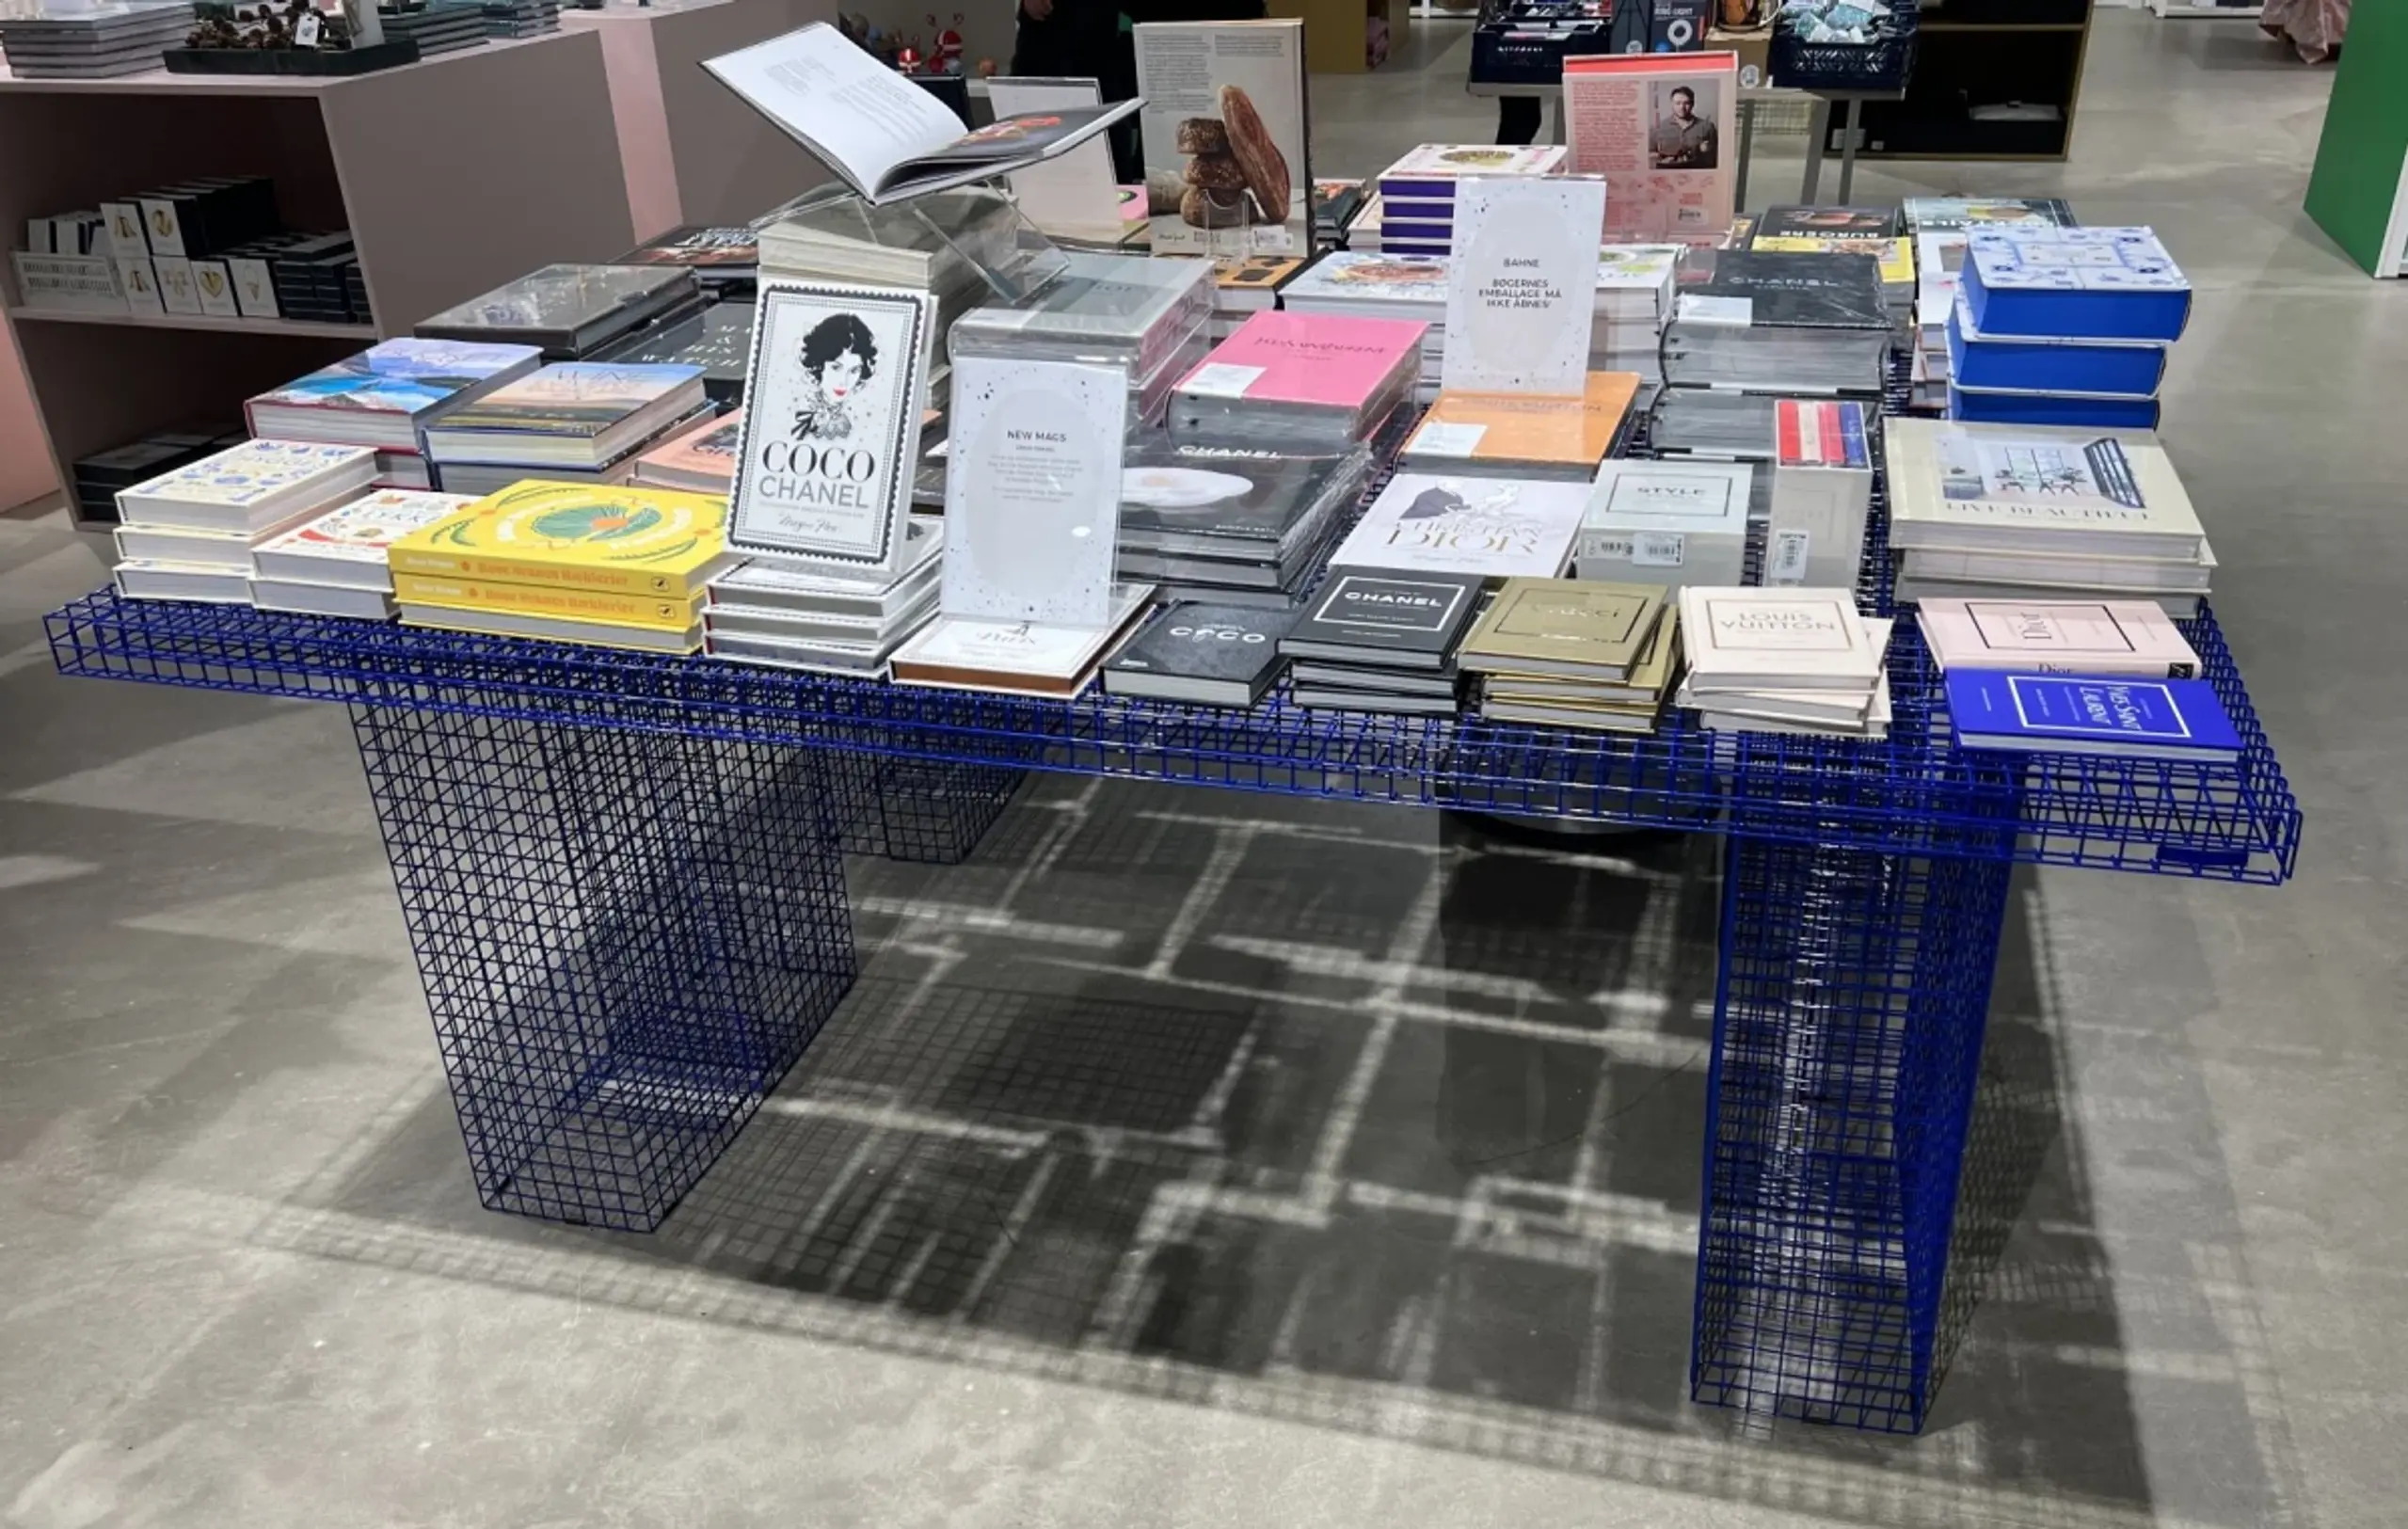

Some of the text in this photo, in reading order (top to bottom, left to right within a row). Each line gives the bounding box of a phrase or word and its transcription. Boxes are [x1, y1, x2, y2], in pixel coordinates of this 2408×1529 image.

[1729, 276, 1840, 288] CHANEL
[1007, 430, 1068, 442] NEW MAGS
[761, 439, 875, 484] COCO
[757, 475, 870, 509] CHANEL
[1636, 486, 1707, 496] STYLE
[1345, 590, 1443, 608] CHANEL
[1738, 612, 1812, 622] LOUIS
[1719, 618, 1836, 630] VUITTON
